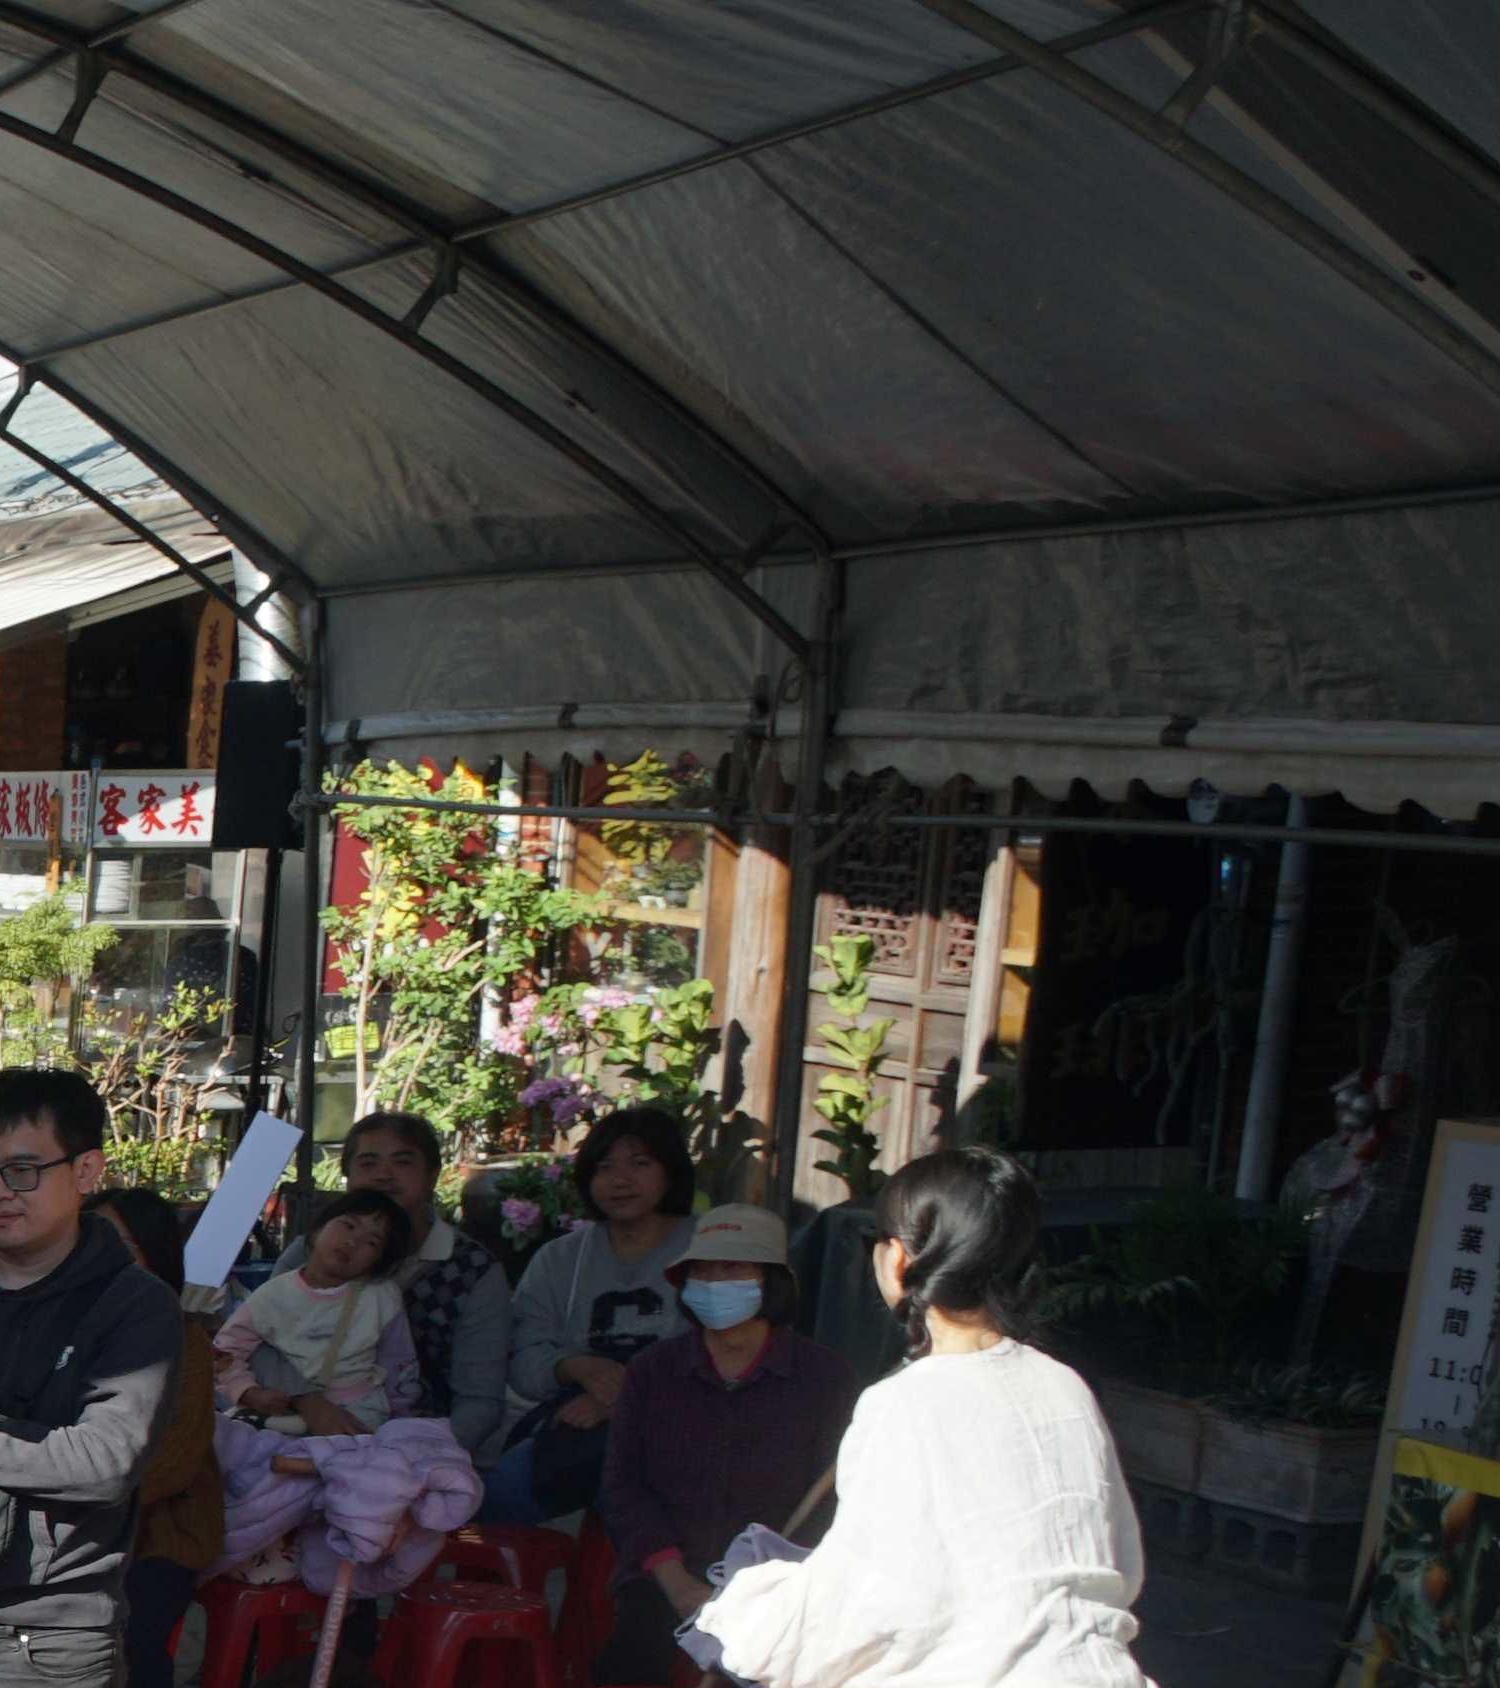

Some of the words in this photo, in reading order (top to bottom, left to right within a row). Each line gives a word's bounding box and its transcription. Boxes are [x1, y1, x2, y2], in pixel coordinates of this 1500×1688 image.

[97, 782, 215, 837] 客家美
[1441, 1183, 1493, 1338] 營業時間
